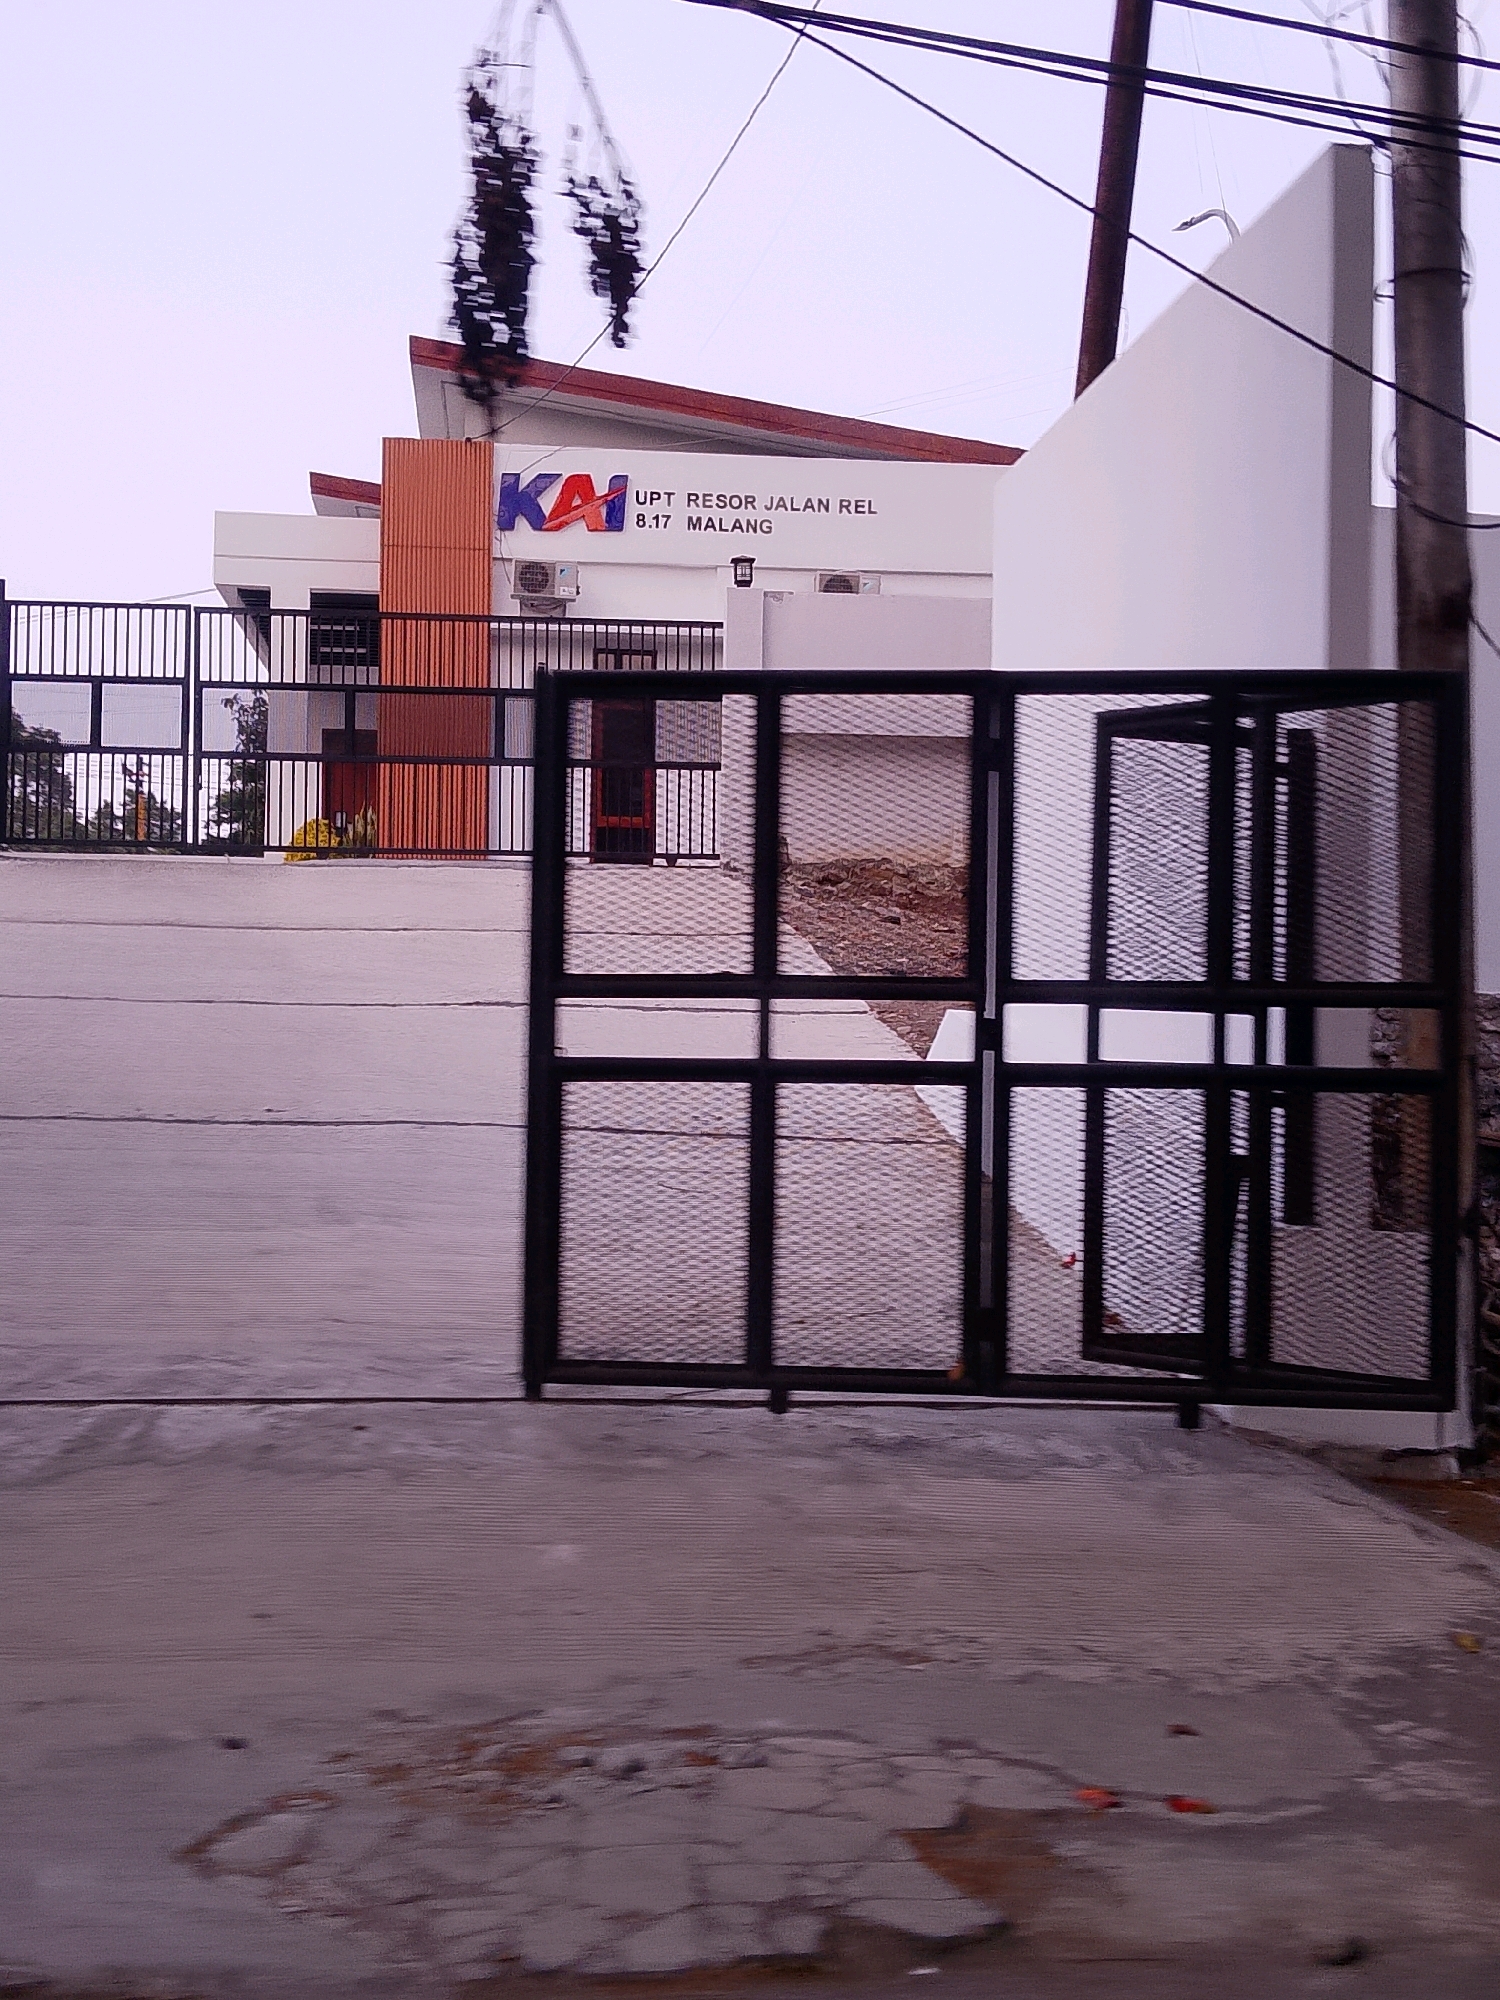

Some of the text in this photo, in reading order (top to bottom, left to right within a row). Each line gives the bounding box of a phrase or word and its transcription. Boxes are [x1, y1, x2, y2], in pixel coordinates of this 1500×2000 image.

[497, 473, 628, 532] KAI
[635, 490, 878, 515] UPT RESOR JALAN REL
[635, 513, 773, 535] 8.17 MALANG
